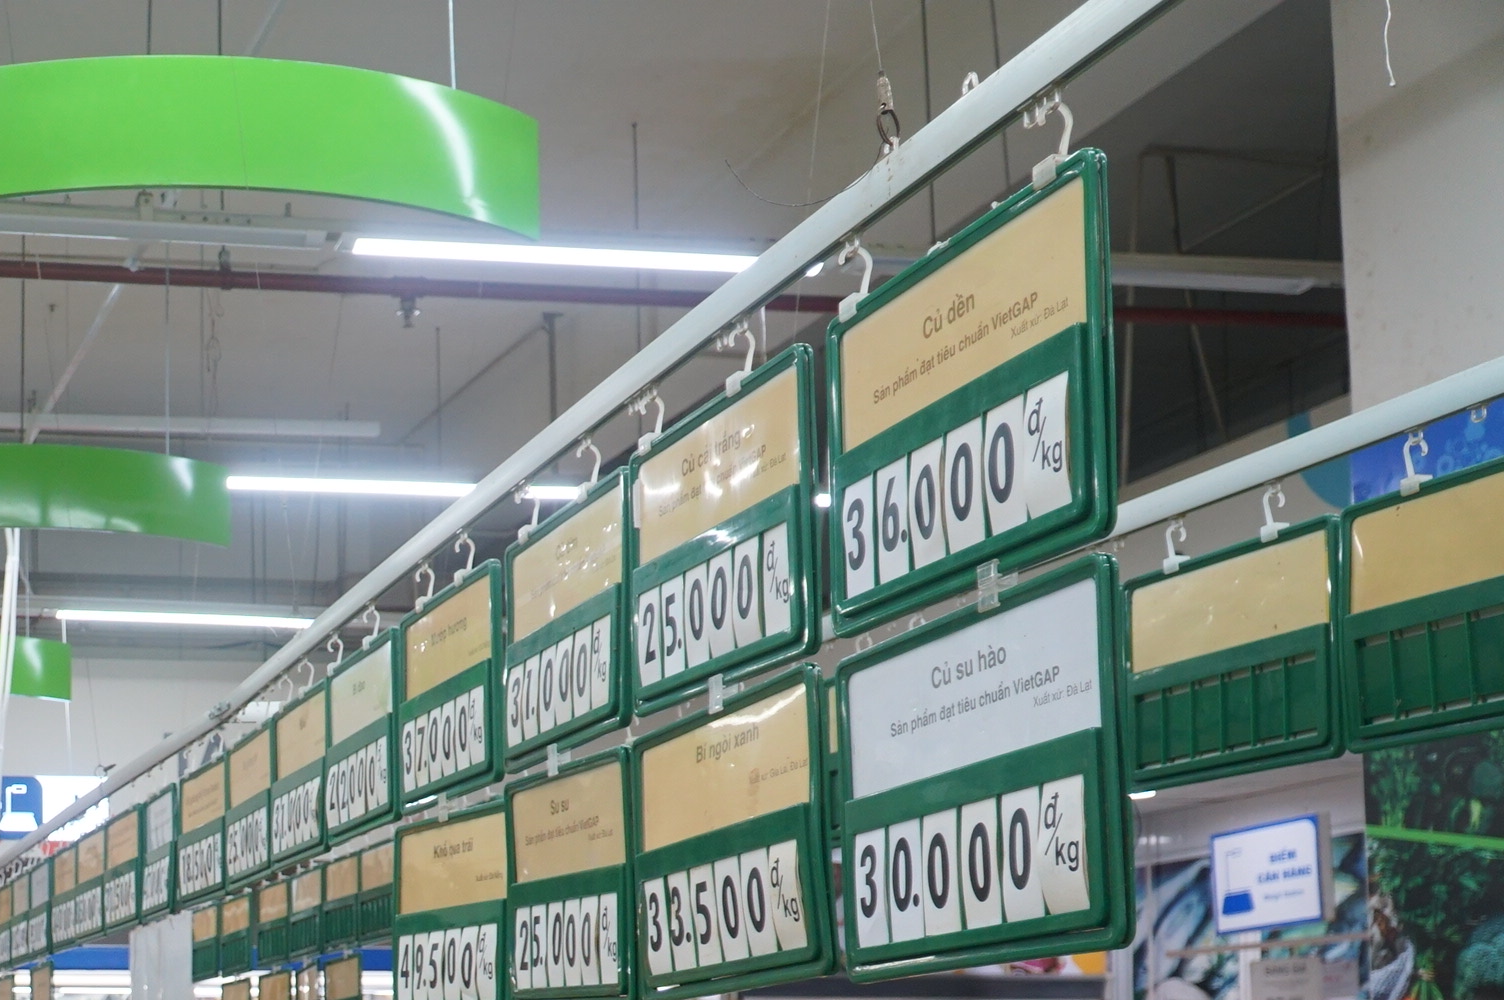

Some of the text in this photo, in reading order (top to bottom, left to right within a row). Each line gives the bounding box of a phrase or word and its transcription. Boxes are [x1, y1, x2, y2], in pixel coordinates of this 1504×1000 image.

[922, 293, 975, 339] Củ dền
[1044, 305, 1055, 320] Đà
[1057, 297, 1069, 312] Lạt
[892, 366, 918, 393] phẩm
[920, 356, 935, 375] đạt
[937, 345, 956, 365] tiêu
[958, 321, 990, 352] chuẩn
[991, 291, 1038, 330] VietGAP
[681, 453, 695, 477] Củ
[846, 422, 1014, 571] 36.000
[642, 554, 753, 664] 25.000
[511, 644, 588, 728] 31.000
[931, 645, 1007, 689] Củ su hào
[1066, 684, 1078, 697] Đà
[1079, 679, 1093, 694] Lạt
[890, 665, 1060, 738] Sản phẩm đạt tiêu chuẩn VietGAP
[404, 705, 467, 775] 37.000
[696, 723, 759, 763] Bí ngòi xanh
[860, 807, 1031, 919] 30.000
[519, 912, 591, 971] 25.000
[649, 867, 766, 952] 33.500
[400, 937, 473, 990] 49.500
